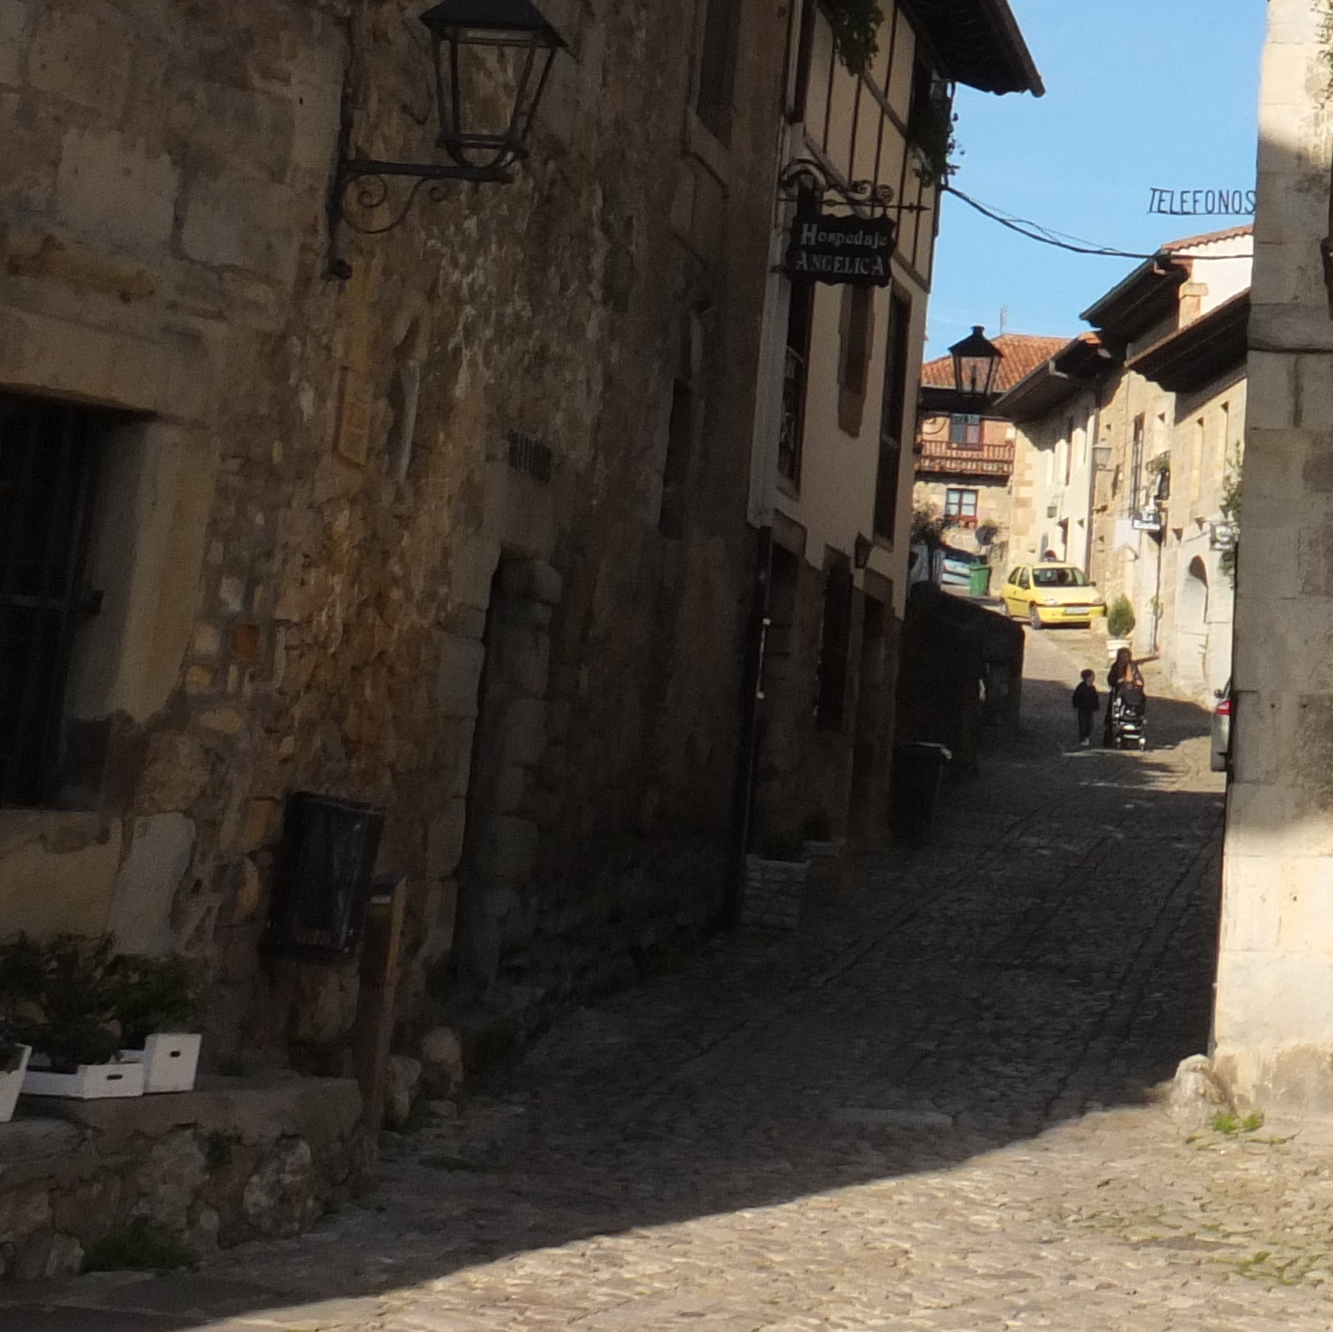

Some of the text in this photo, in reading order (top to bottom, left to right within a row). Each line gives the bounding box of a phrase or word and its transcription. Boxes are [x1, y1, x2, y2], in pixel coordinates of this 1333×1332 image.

[1147, 187, 1256, 215] TELEFONOS
[800, 223, 888, 249] Hospedaje
[795, 250, 885, 276] ANGELICA
